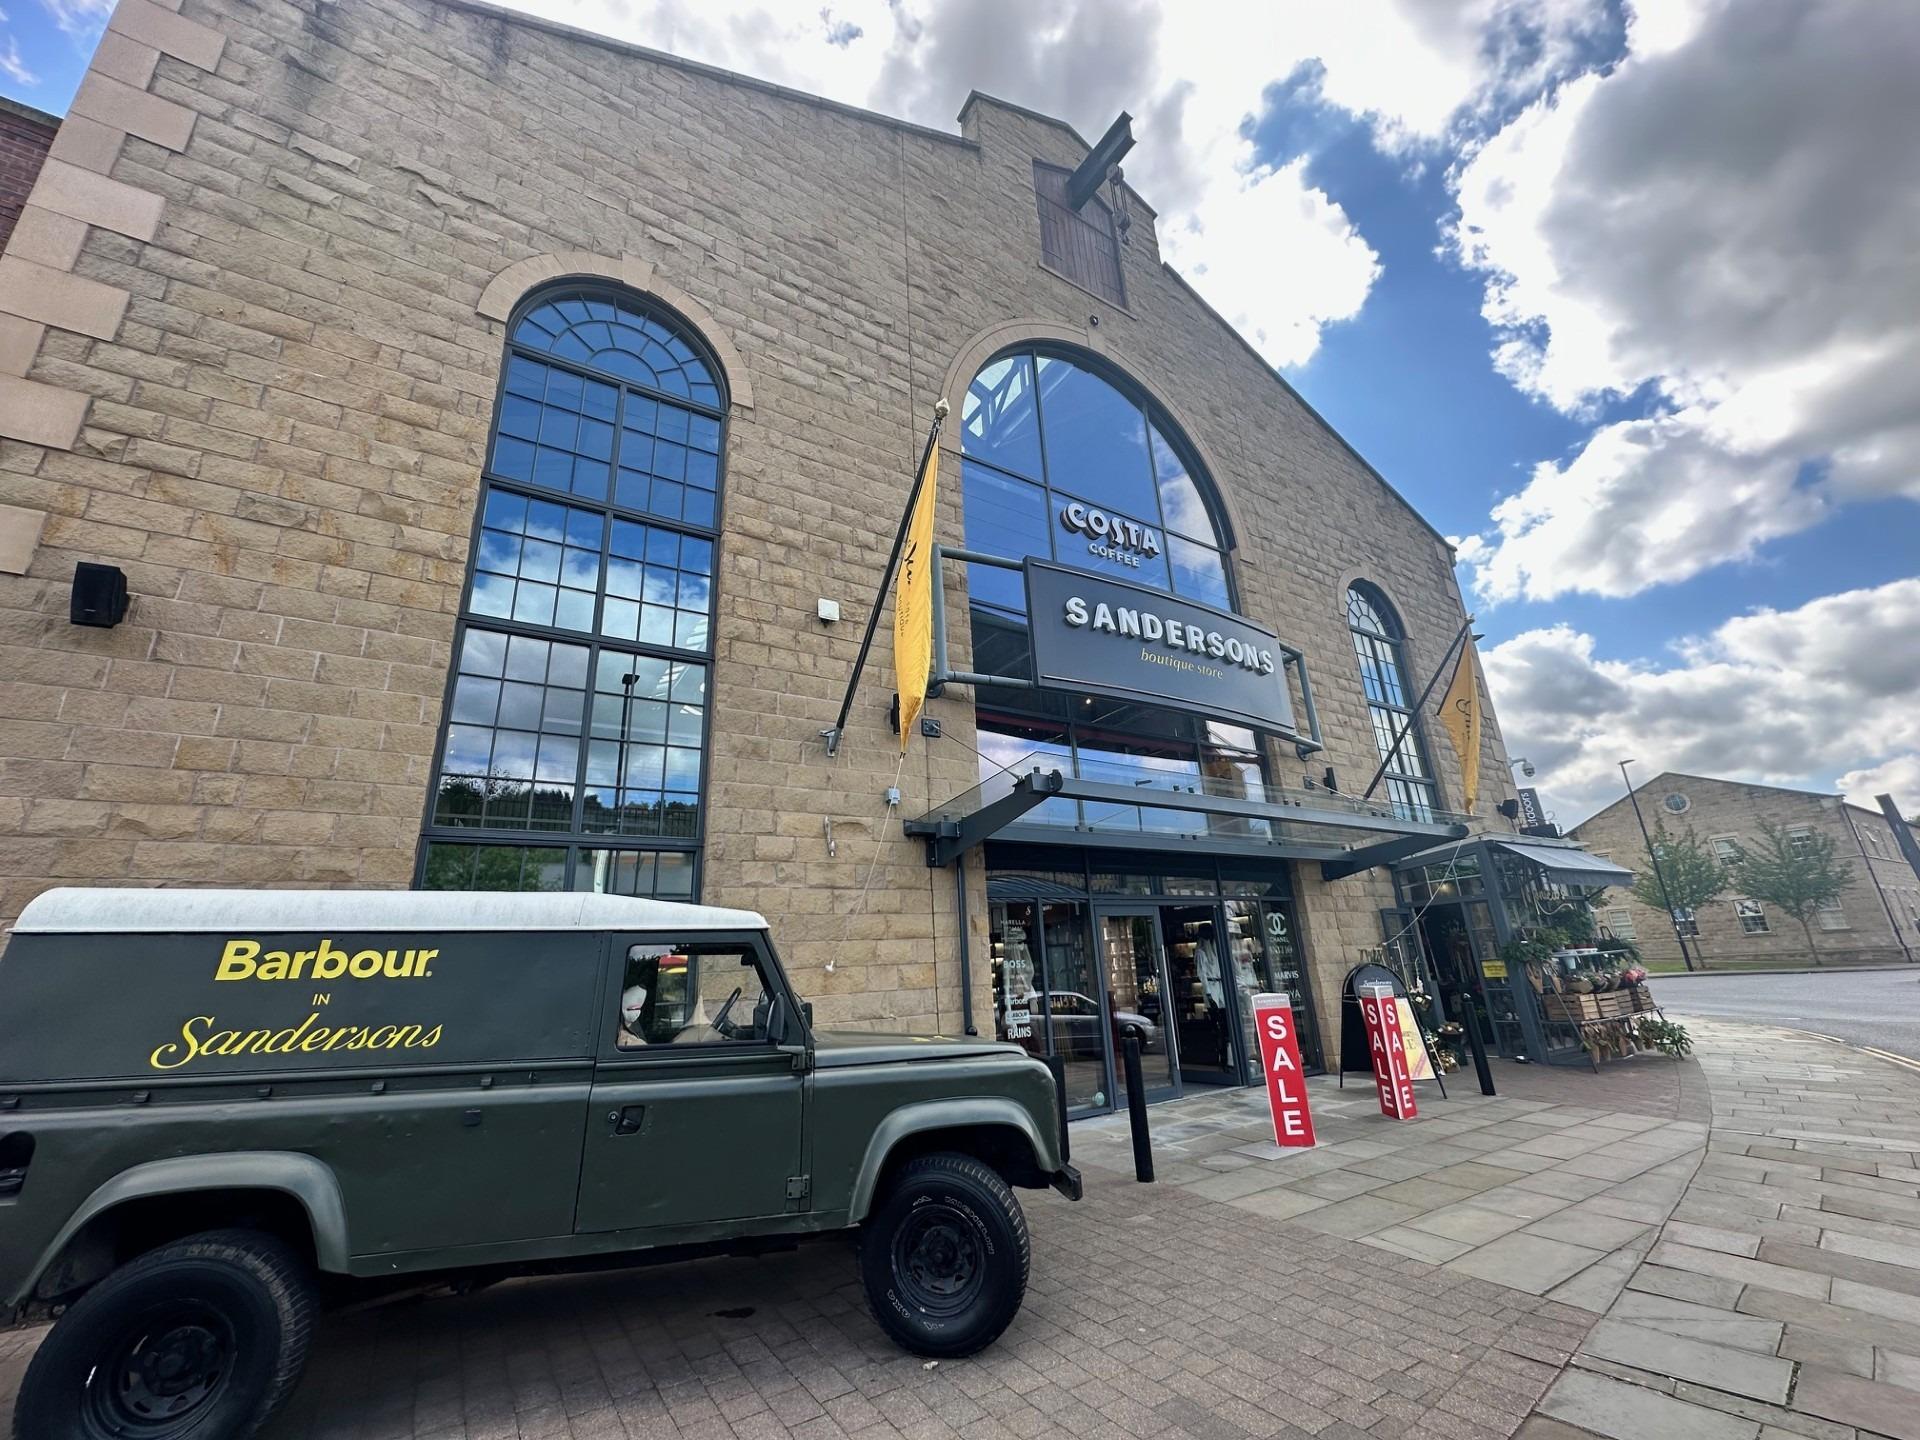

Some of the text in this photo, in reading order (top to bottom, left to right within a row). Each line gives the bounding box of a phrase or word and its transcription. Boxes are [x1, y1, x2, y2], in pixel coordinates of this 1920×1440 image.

[1060, 502, 1161, 559] COSTA
[1088, 543, 1140, 568] COFFEE
[1065, 596, 1275, 675] SANDERSONS
[1140, 648, 1223, 680] boutique store
[215, 939, 439, 981] Barbour
[1003, 960, 1026, 969] BOSS
[1274, 970, 1300, 979] MARVIS
[312, 993, 330, 1006] IN
[150, 1013, 443, 1069] Sandersons
[1007, 1026, 1032, 1039] RAINS
[1267, 1015, 1305, 1136] SALE
[1368, 1003, 1394, 1109] SALE
[1385, 1003, 1412, 1109] SALE
